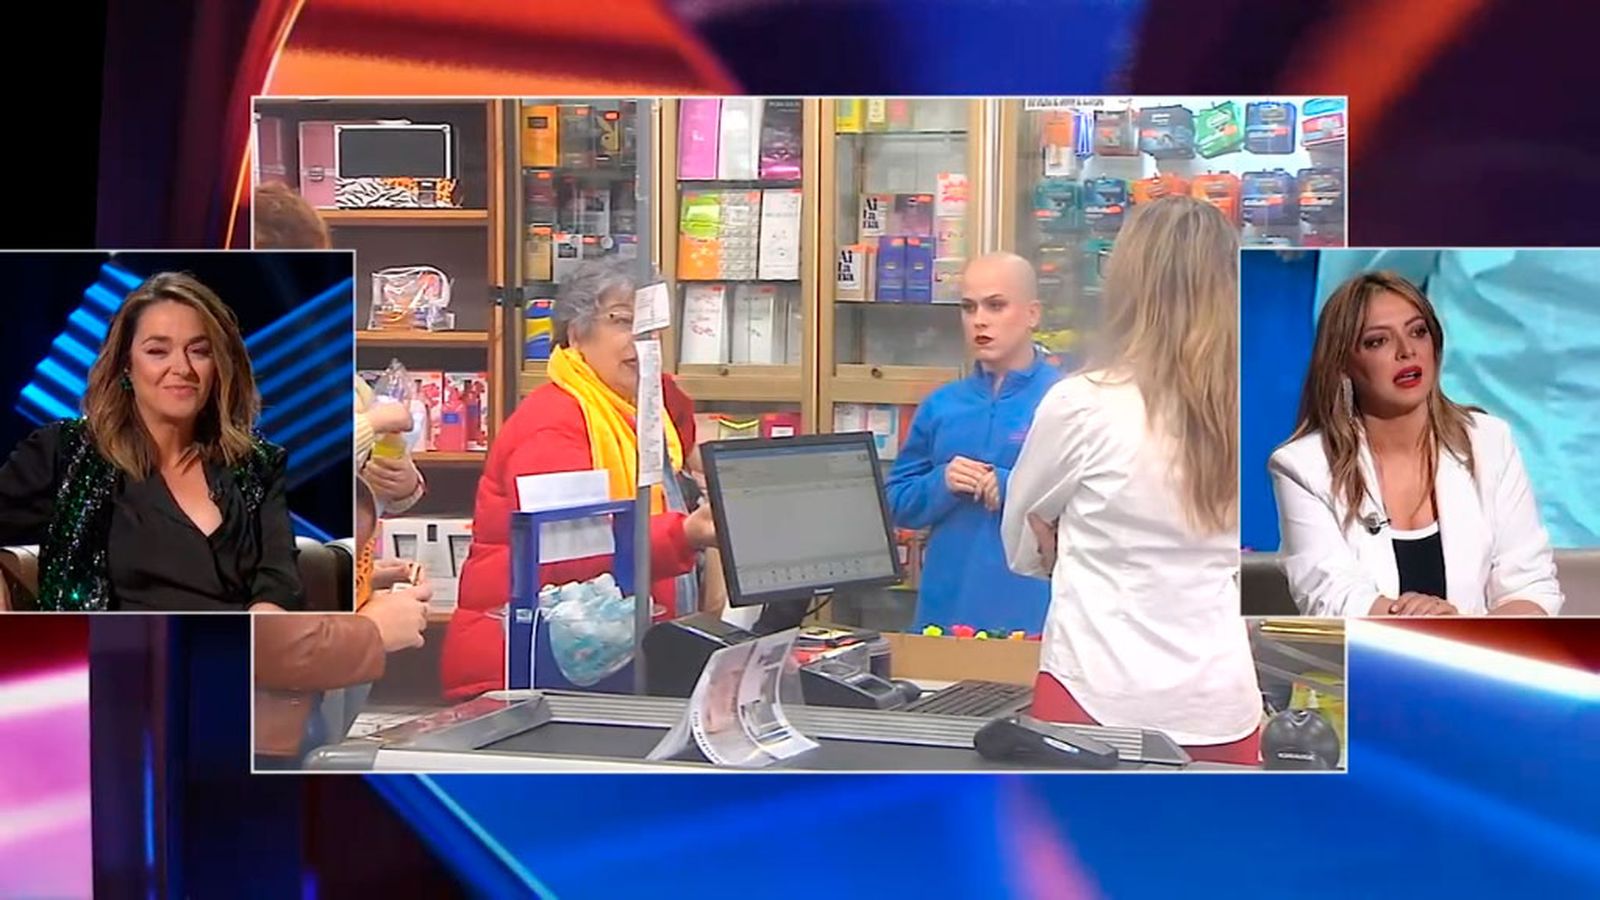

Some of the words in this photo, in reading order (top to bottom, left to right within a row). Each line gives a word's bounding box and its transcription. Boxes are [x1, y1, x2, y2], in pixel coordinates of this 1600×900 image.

[863, 209, 876, 220] ta
[863, 220, 879, 229] na
[838, 262, 851, 273] ta
[838, 273, 854, 282] na
